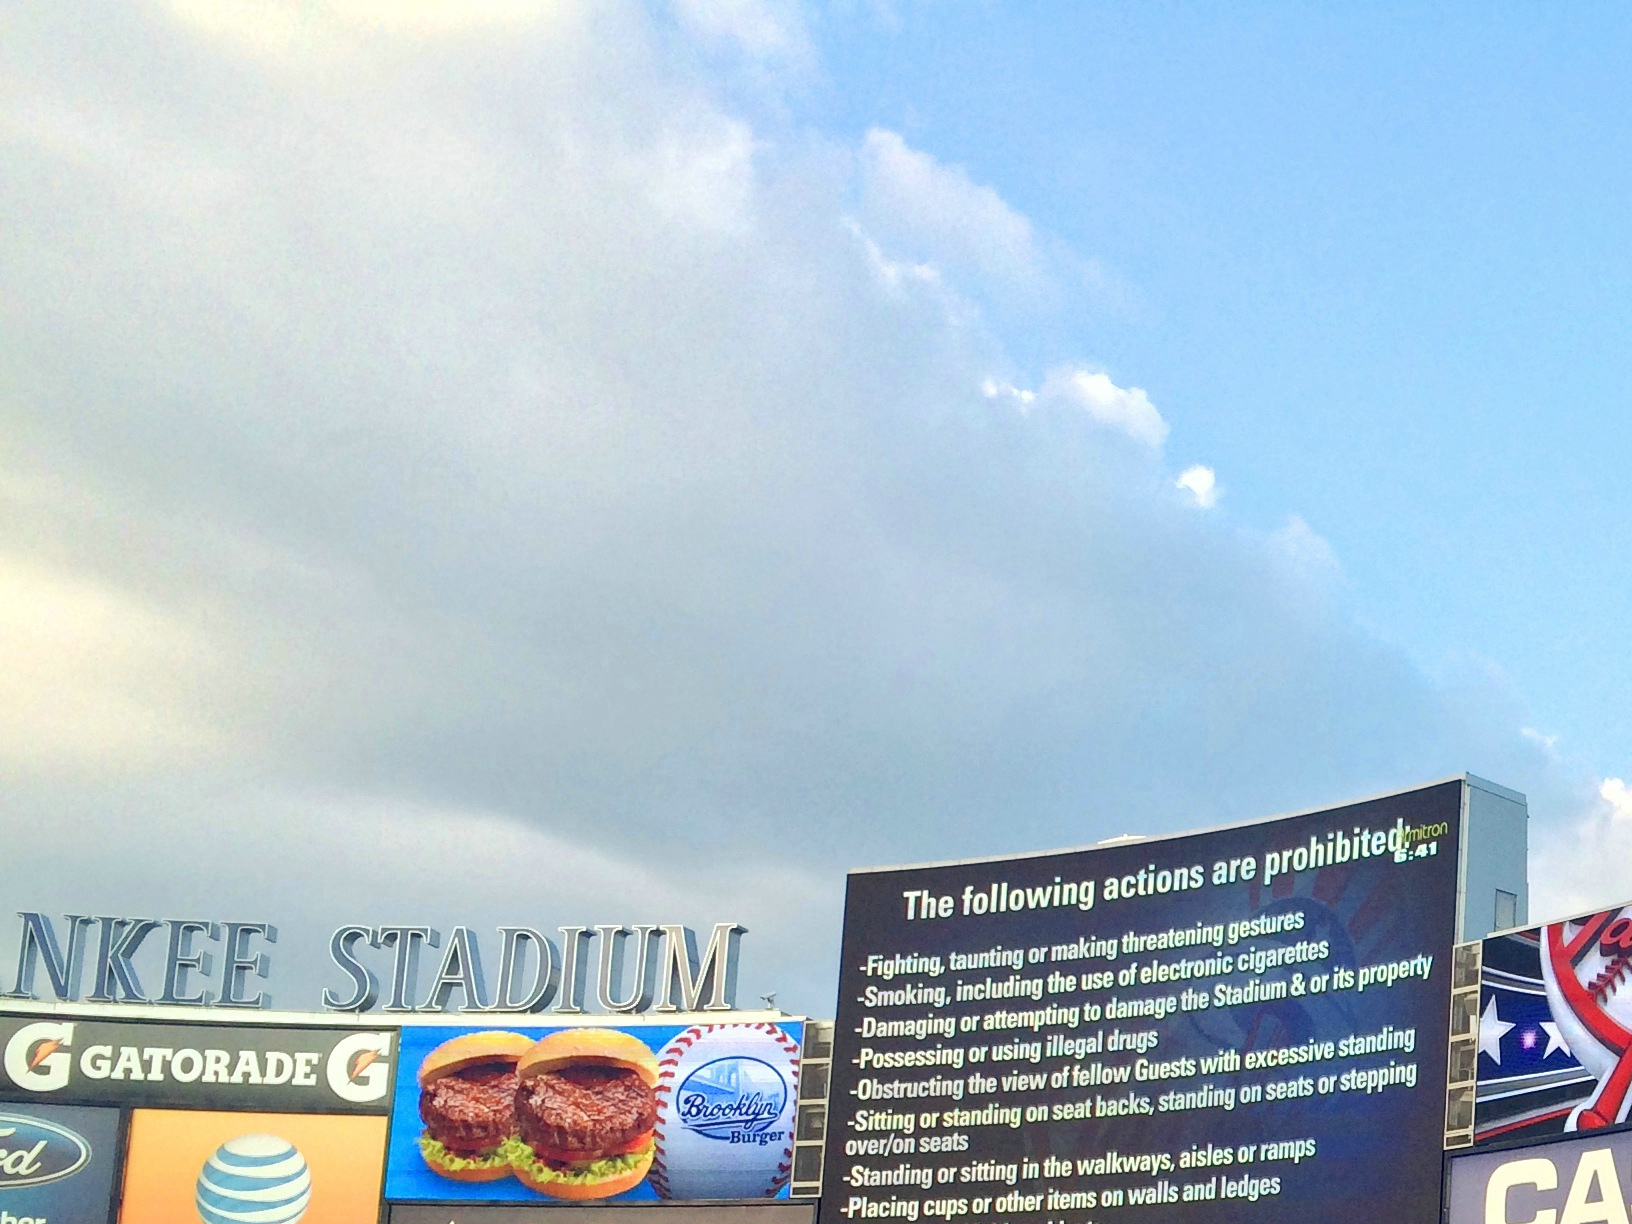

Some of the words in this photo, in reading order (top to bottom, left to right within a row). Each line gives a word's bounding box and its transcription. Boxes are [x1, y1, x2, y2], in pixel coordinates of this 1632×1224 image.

[1394, 841, 1437, 863] 6:41
[903, 889, 954, 920] The
[962, 876, 1095, 915] following
[1104, 864, 1204, 901] actions
[1212, 857, 1256, 885] are
[322, 922, 748, 1013] STADIUM
[859, 952, 945, 980] -Fighting,
[949, 945, 1024, 971] taunting
[1028, 946, 1048, 964] or
[1051, 936, 1117, 961] making
[1122, 922, 1223, 951] threatening
[1228, 911, 1305, 945] gestures
[854, 1014, 955, 1040] -Damaging
[960, 1015, 980, 1032] or
[983, 1003, 1079, 1031] attempting
[1083, 1002, 1101, 1021] to
[1105, 994, 1176, 1021] damage
[1181, 988, 1209, 1012] the
[1214, 979, 1286, 1008] Stadium
[1290, 973, 1305, 996] &
[1310, 975, 1329, 993] or
[1333, 967, 1354, 988] its
[1358, 954, 1432, 991] property
[857, 983, 951, 1008] -Smoking,
[956, 975, 1043, 1002] including
[1047, 973, 1076, 994] the
[1081, 969, 1113, 991] use
[1118, 962, 1137, 986] of
[1140, 952, 1233, 984] electronic
[1237, 939, 1329, 973] cigarettes
[80, 1045, 322, 1086] GATORADE
[849, 1075, 964, 1101] -Obstructing
[967, 1072, 997, 1094] the
[1001, 1070, 1047, 1091] view
[1051, 1066, 1071, 1089] of
[1073, 1062, 1130, 1087] fellow
[1135, 1058, 1196, 1082] Guests
[1200, 1049, 1241, 1075] with
[1245, 1039, 1334, 1070] excessive
[1338, 1025, 1415, 1057] standing
[851, 1044, 964, 1070] -Possessing
[969, 1046, 988, 1064] or
[992, 1038, 1041, 1063] using
[1046, 1031, 1102, 1060] illegal
[1107, 1028, 1158, 1053] drugs
[681, 1092, 778, 1129] Brooklyn
[847, 1110, 915, 1134] -Sitting
[919, 1111, 939, 1129] or
[942, 1103, 1022, 1129] standing
[1026, 1105, 1048, 1122] on
[1052, 1100, 1092, 1120] seat
[1095, 1094, 1154, 1117] backs,
[1158, 1084, 1236, 1113] standing
[1240, 1084, 1262, 1103] on
[1265, 1078, 1314, 1101] seats
[1318, 1076, 1337, 1094] or
[1340, 1061, 1417, 1094] stepping
[730, 1131, 784, 1145] Burger
[842, 1163, 933, 1190] -Standing
[937, 1166, 957, 1183] or
[960, 1160, 1018, 1185] sitting
[1022, 1157, 1040, 1179] in
[1043, 1156, 1072, 1178] the
[1077, 1151, 1175, 1176] walkways,
[1179, 1142, 1233, 1168] aisles
[1237, 1146, 1258, 1164] or
[1260, 1137, 1316, 1163] ramps
[845, 1133, 915, 1156] over/on
[919, 1132, 969, 1153] seats
[840, 1196, 919, 1221] -Placing
[923, 1199, 968, 1220] cups
[972, 1197, 992, 1214] or
[995, 1189, 1044, 1213] other
[1047, 1188, 1097, 1210] items
[1101, 1189, 1123, 1208] on
[1128, 1181, 1179, 1205] walls
[1182, 1177, 1216, 1201] and
[1220, 1174, 1281, 1201] ledges
